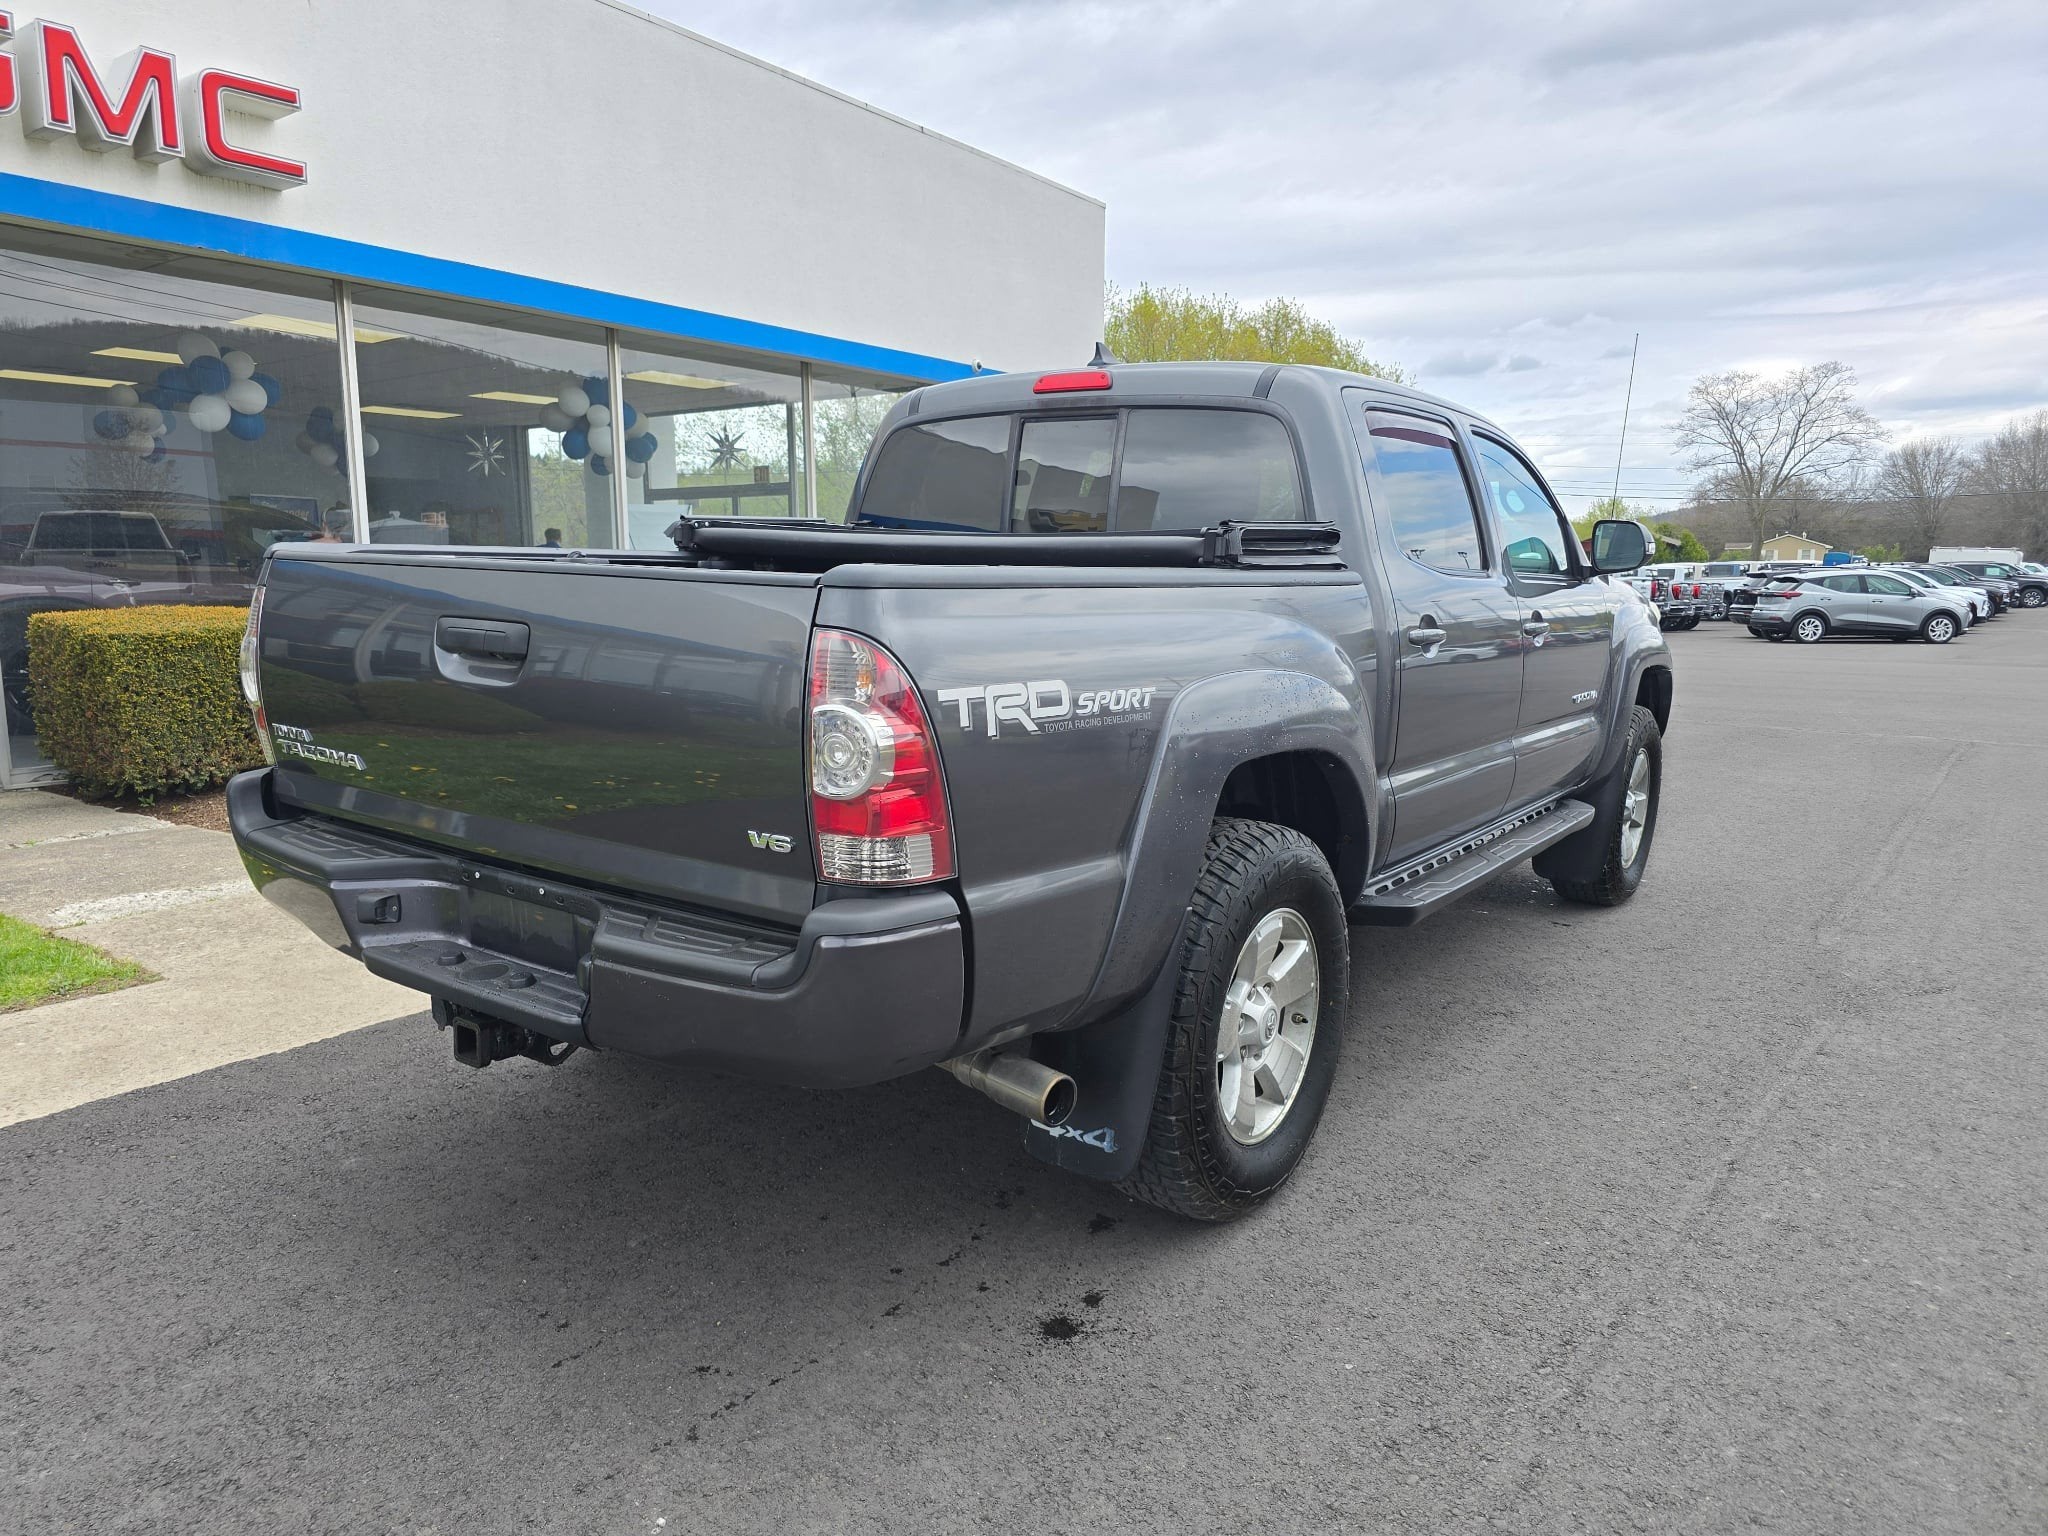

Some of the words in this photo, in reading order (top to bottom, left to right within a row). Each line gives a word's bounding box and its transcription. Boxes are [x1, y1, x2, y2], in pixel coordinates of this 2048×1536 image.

[0, 9, 308, 186] MC
[938, 679, 1073, 740] TRD
[1076, 686, 1157, 716] SPORT
[1044, 720, 1073, 733] TOYOTA
[1075, 718, 1102, 729] RACING
[1103, 711, 1152, 726] DEVELOPMENT
[272, 722, 314, 743] TOYOTA
[276, 738, 367, 771] TACOMA
[747, 830, 792, 853] V6
